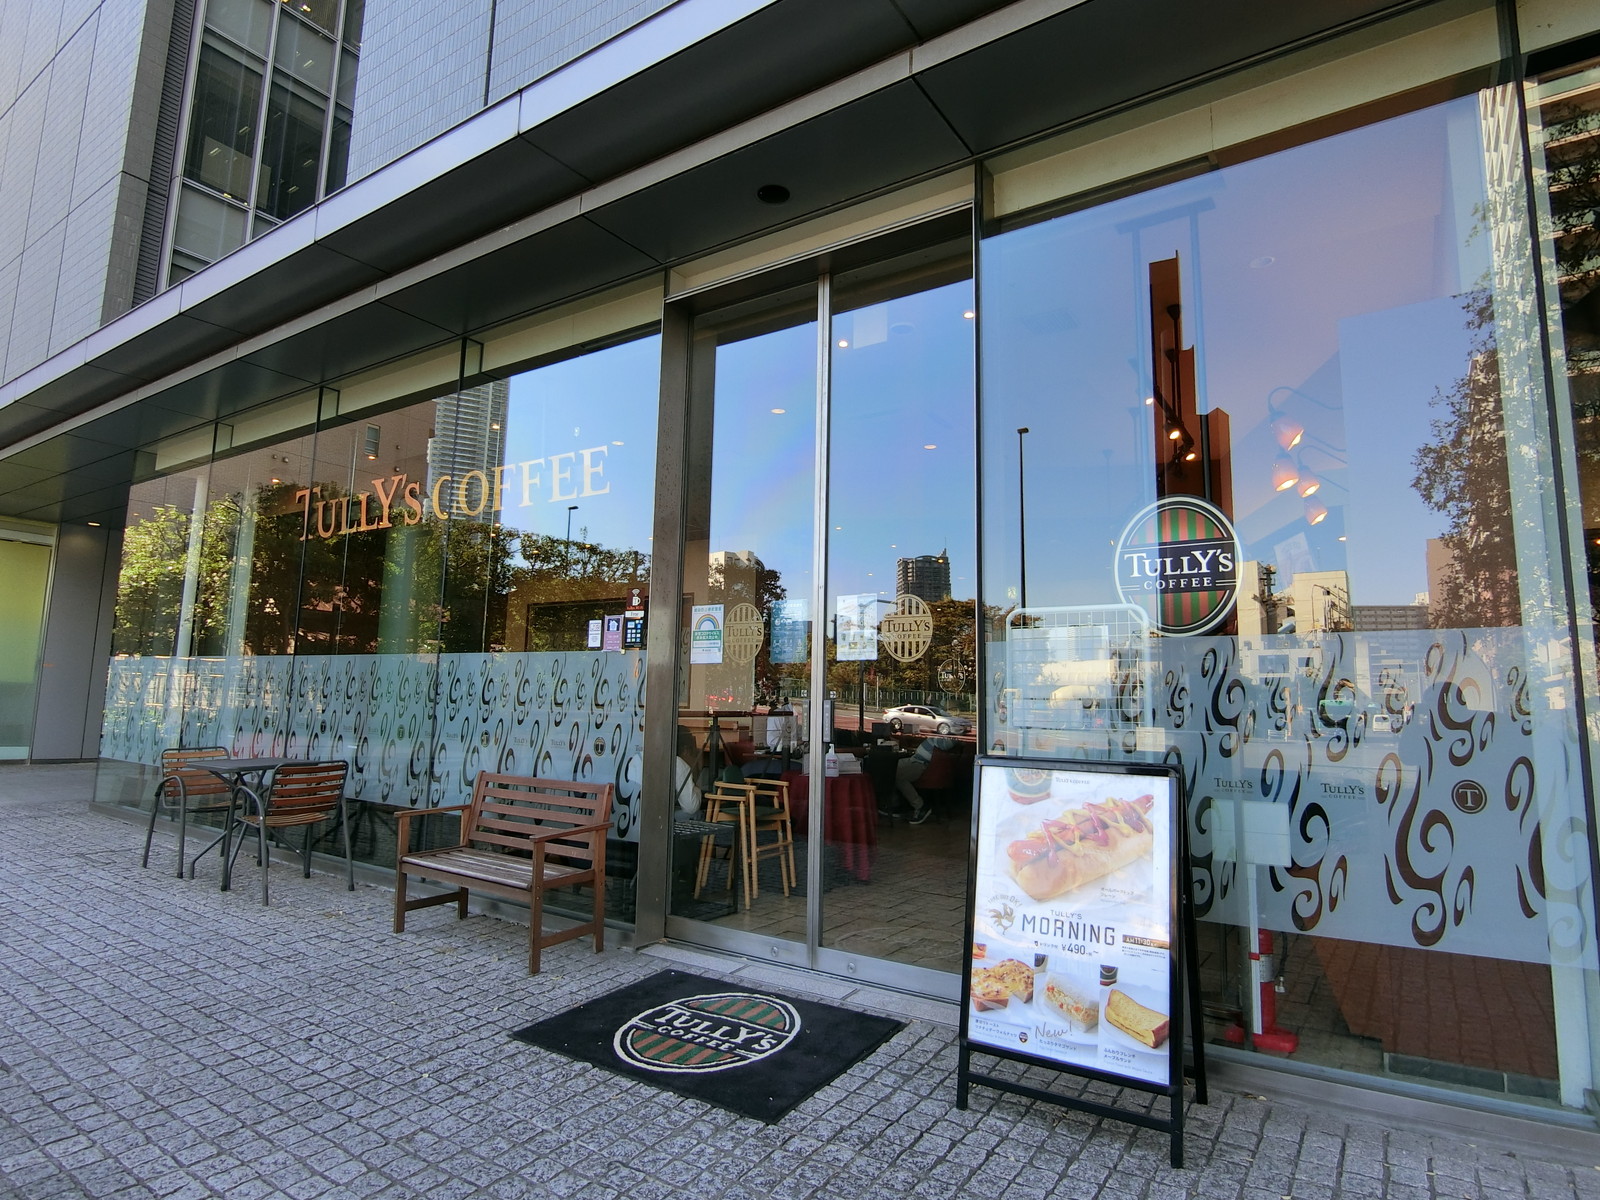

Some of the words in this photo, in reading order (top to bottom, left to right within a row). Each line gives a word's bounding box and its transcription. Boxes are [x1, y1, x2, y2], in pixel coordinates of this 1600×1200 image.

[295, 473, 422, 541] TULLY'S
[432, 445, 610, 520] COFFEE
[1124, 548, 1233, 578] TULLY'S
[1143, 577, 1213, 590] COFFEE
[884, 619, 931, 633] TULLY'S
[1320, 782, 1365, 795] TULLY'S
[1458, 788, 1479, 807] T
[1050, 909, 1083, 920] TULLY'S
[1021, 913, 1116, 946] MORNING
[654, 1006, 778, 1052] TULLY'S
[657, 1025, 737, 1051] COFFEE
[1034, 1020, 1073, 1039] New!
